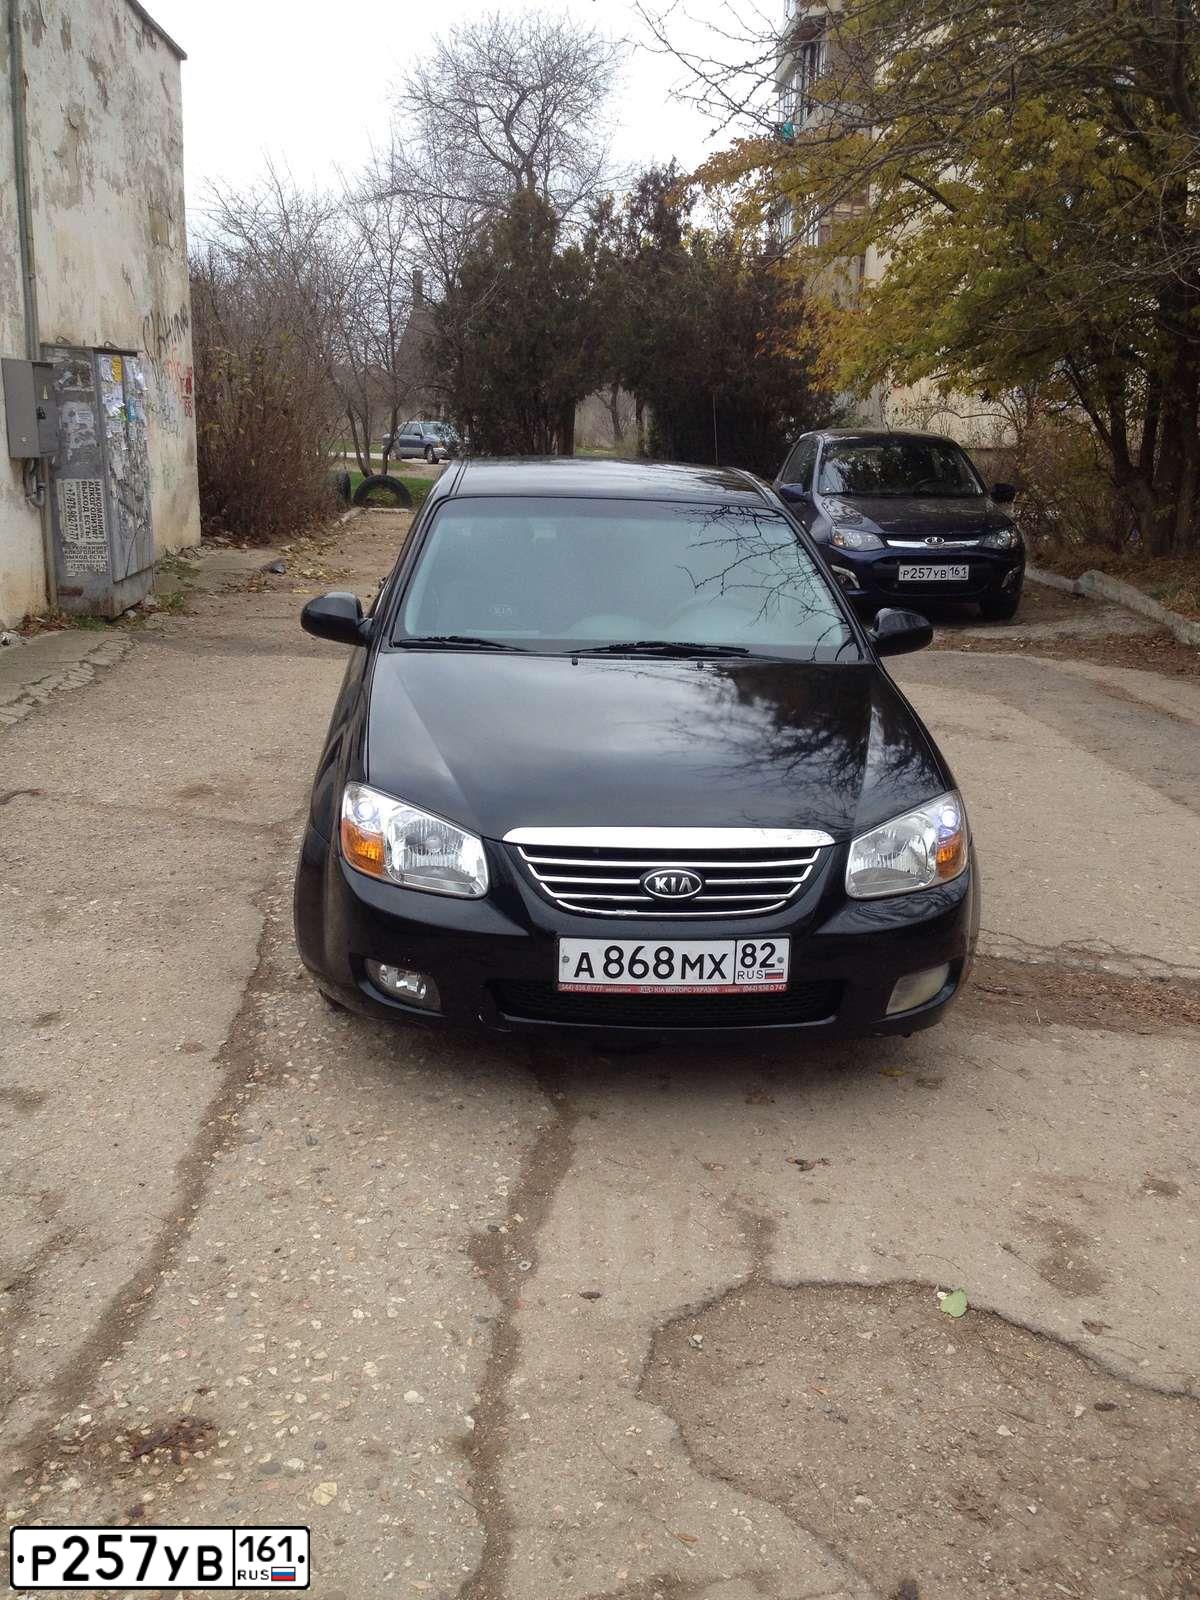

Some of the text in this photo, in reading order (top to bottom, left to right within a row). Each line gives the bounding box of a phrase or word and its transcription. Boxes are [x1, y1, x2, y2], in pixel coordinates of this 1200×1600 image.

[81, 480, 89, 513] ВЫХОД
[903, 567, 967, 579] Р257УВ 161
[654, 876, 693, 892] KIA
[573, 942, 776, 980] А868МХ 82
[737, 970, 764, 980] RUS
